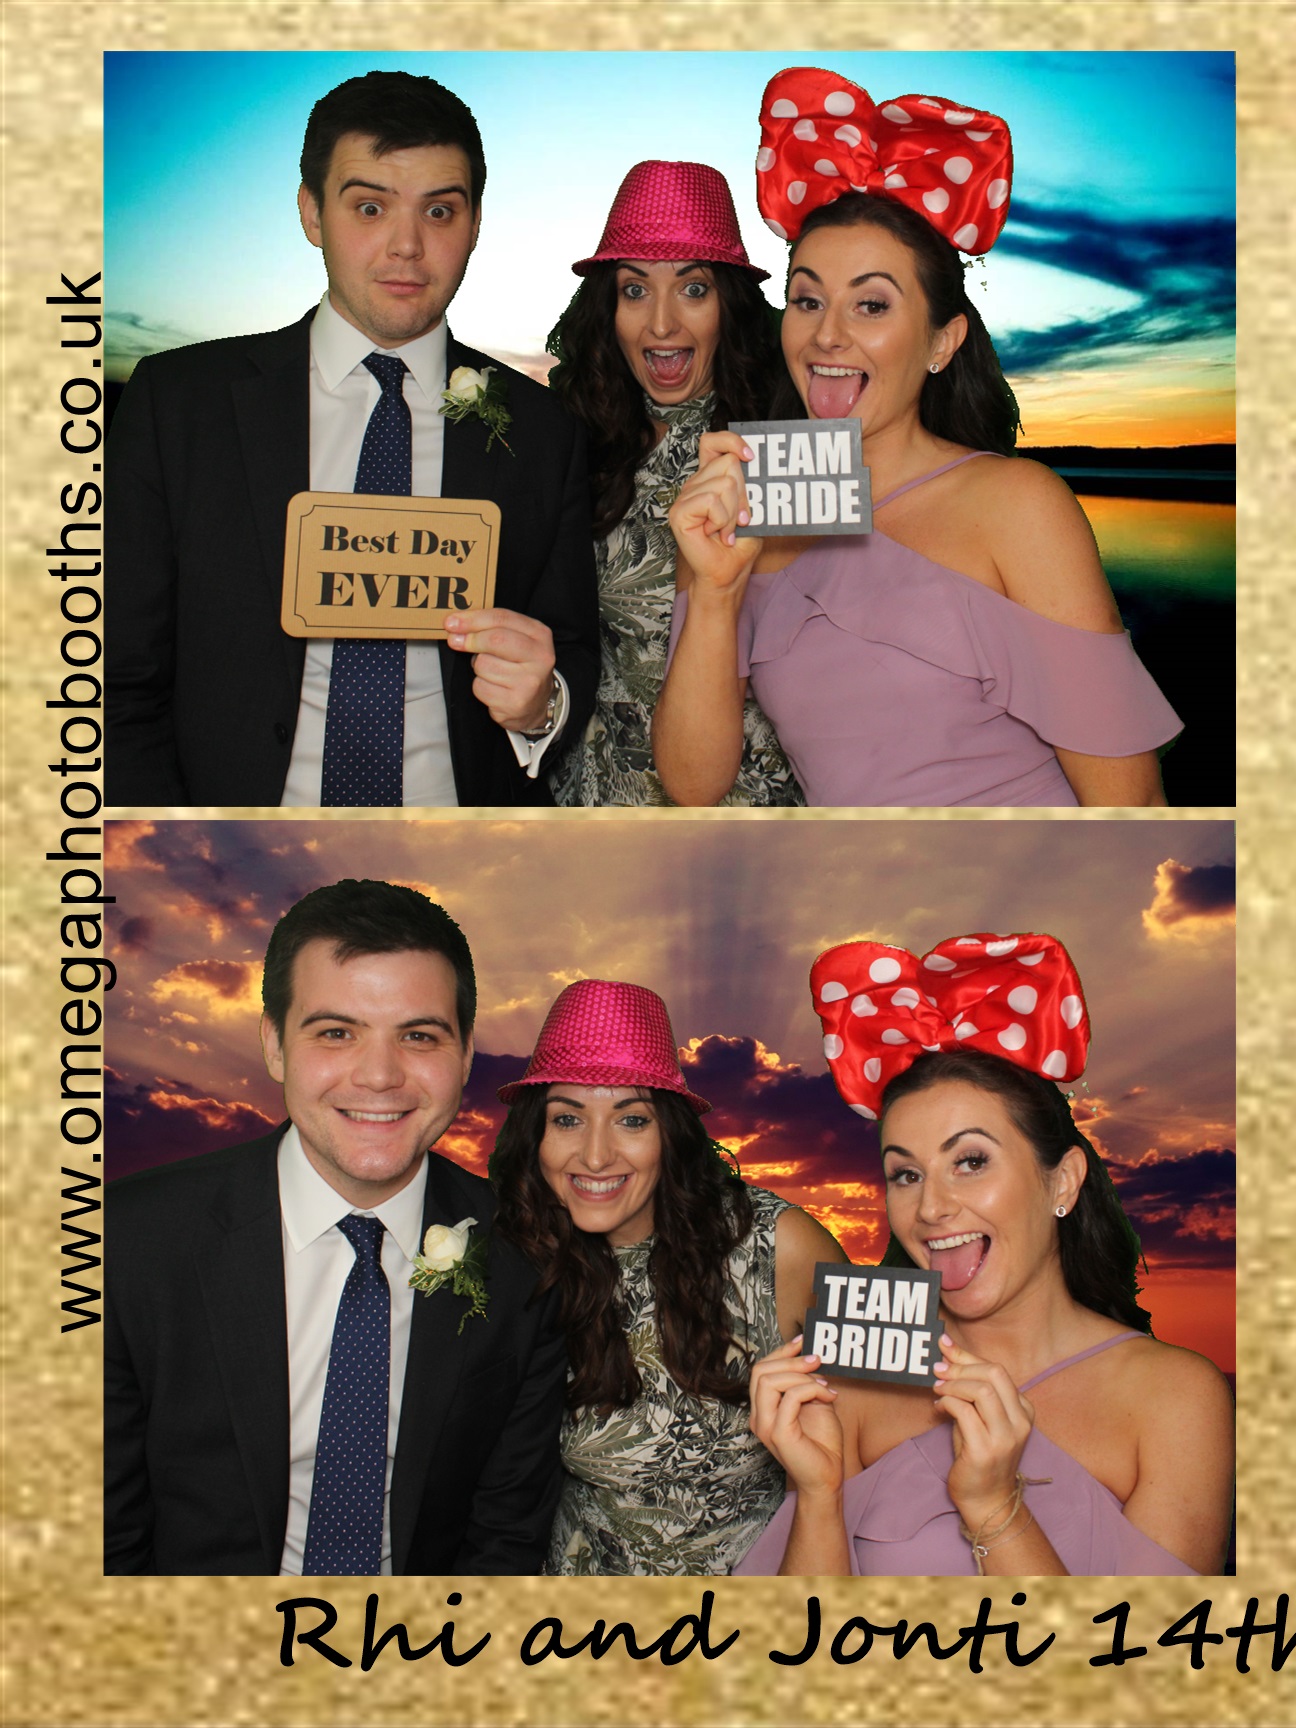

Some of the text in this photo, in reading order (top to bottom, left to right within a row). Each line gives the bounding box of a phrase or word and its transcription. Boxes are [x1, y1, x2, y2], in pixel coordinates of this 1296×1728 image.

[741, 431, 852, 477] TEAM
[745, 480, 861, 526] BRIDE
[320, 525, 477, 564] Best Day
[315, 571, 473, 610] EVER
[824, 1275, 929, 1325] TEAM
[813, 1321, 931, 1375] BRIDE
